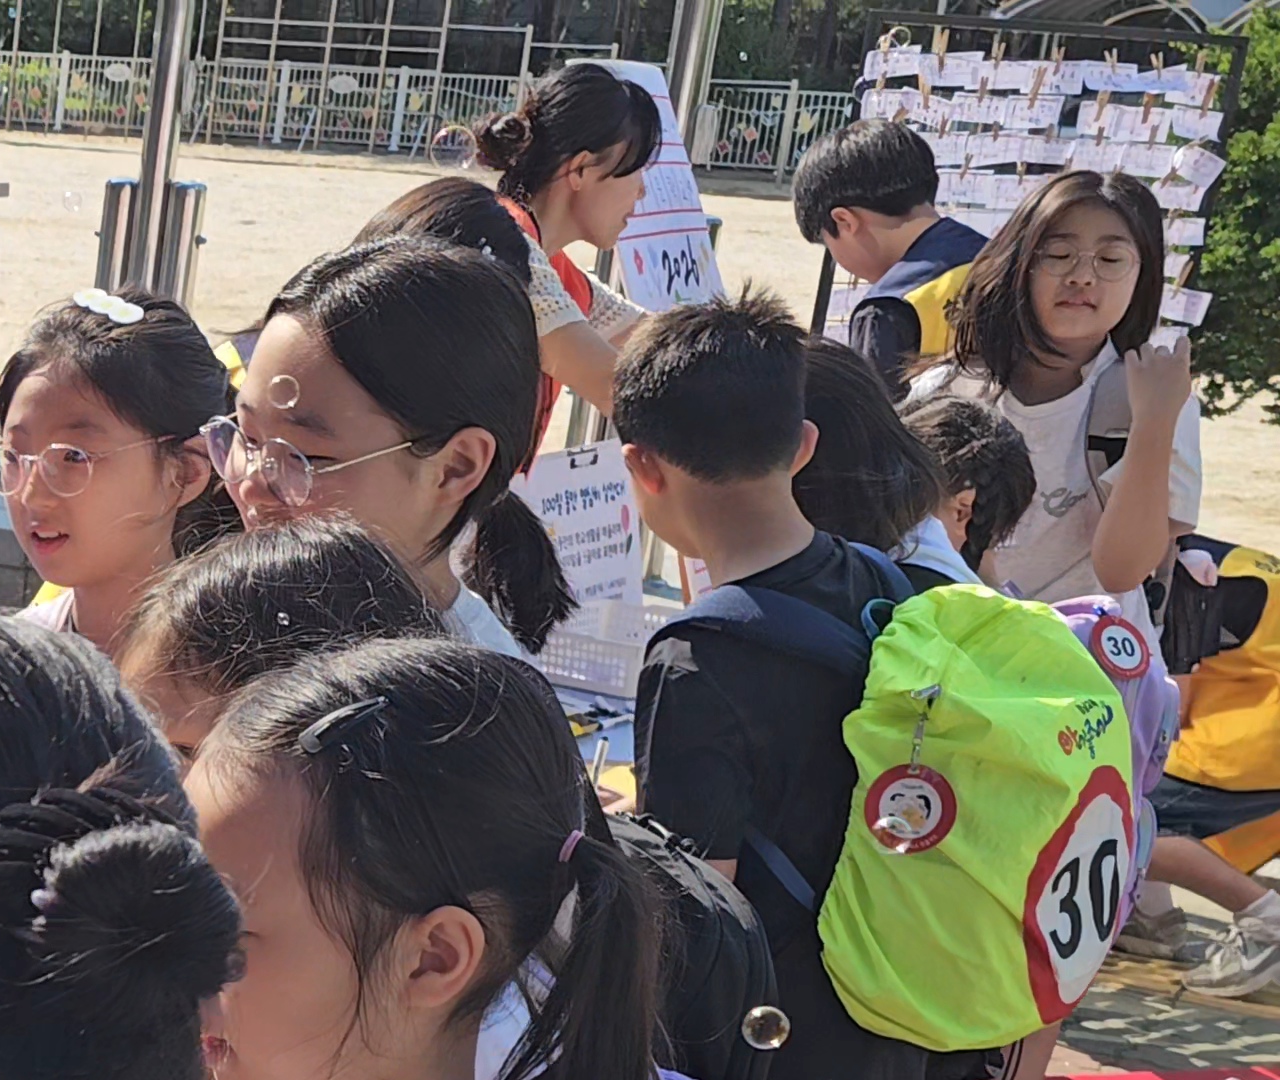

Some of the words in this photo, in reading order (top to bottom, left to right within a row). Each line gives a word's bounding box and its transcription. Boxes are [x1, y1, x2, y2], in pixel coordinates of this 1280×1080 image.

[662, 234, 700, 297] 2026
[1106, 636, 1136, 658] 30
[1049, 838, 1121, 960] 30
